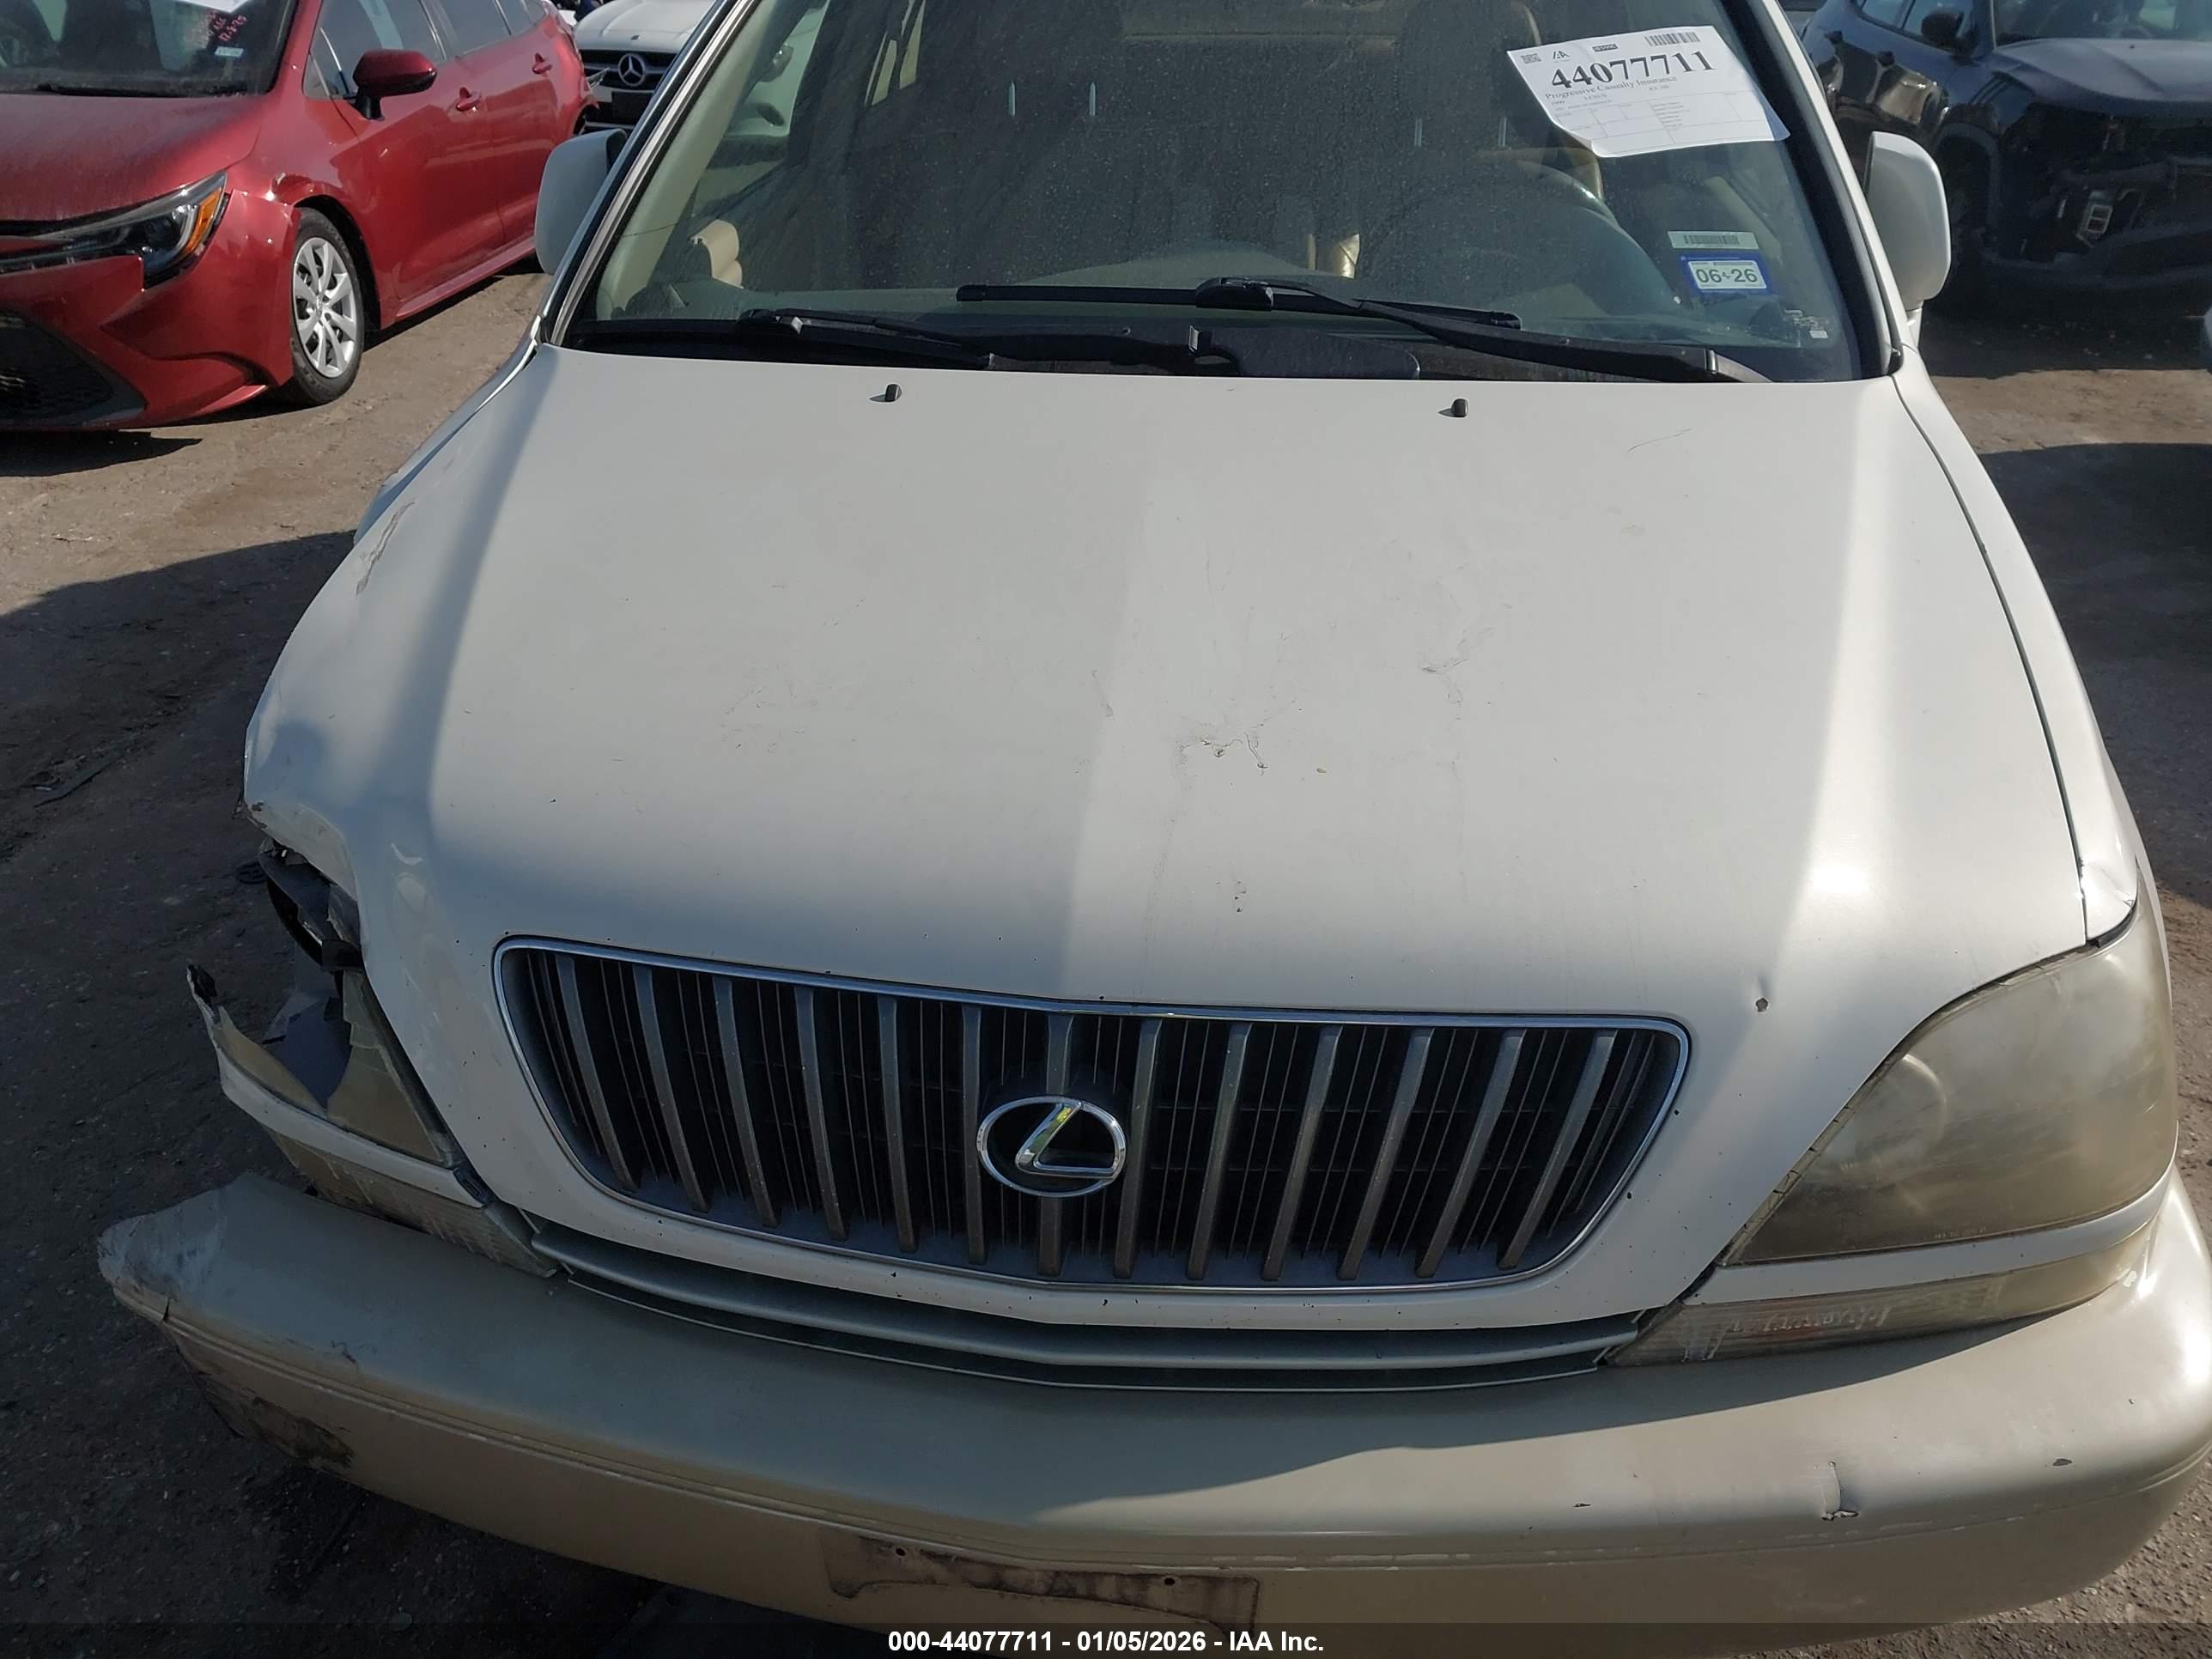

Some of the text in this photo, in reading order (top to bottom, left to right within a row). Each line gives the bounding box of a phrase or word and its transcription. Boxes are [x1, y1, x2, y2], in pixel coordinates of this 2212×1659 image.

[1552, 51, 1717, 88] 44077711
[1545, 87, 1595, 100] Progressive
[1596, 80, 1635, 92] Casualty
[1636, 76, 1677, 87] Insurance
[1696, 268, 1759, 283] 06 26
